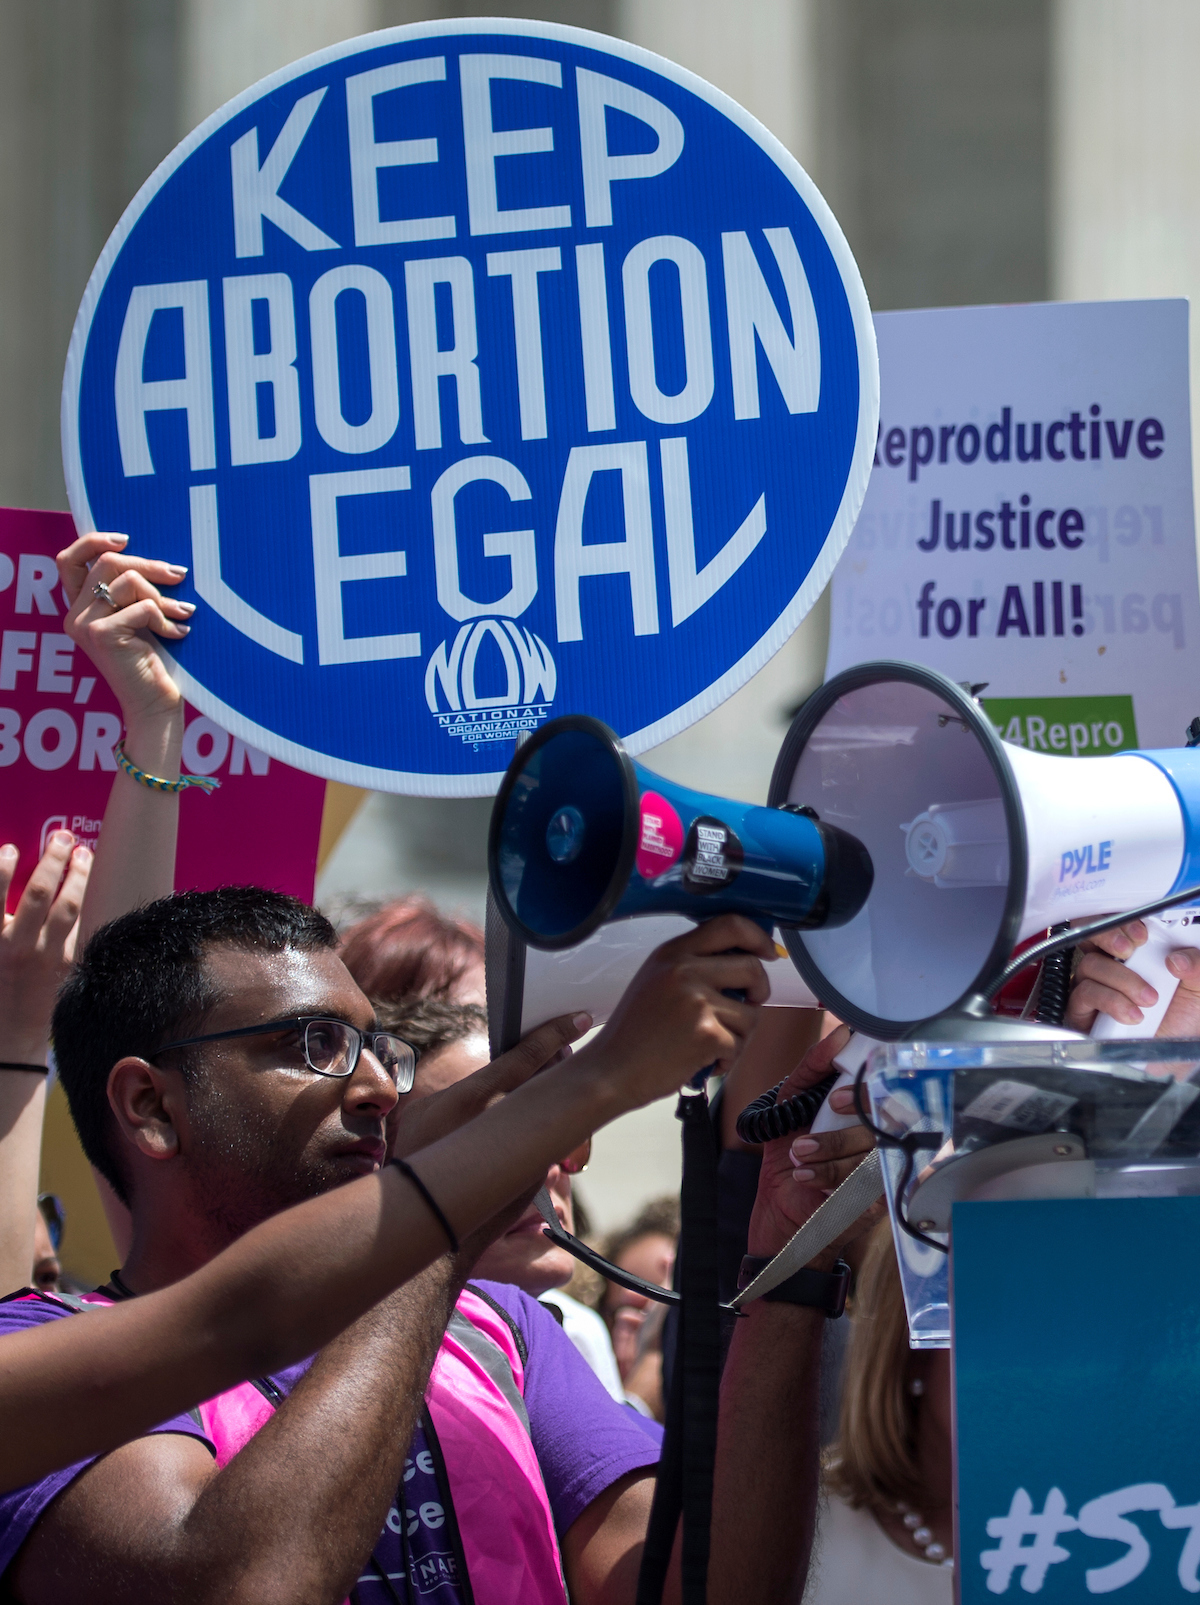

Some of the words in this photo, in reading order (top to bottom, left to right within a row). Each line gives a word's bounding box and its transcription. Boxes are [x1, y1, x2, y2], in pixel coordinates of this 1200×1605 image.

[231, 53, 685, 258] KEEP
[115, 227, 822, 478] ABORTION
[917, 494, 1085, 552] Justice
[189, 437, 767, 667] LEGAL
[916, 581, 986, 639] for
[996, 580, 1086, 639] All!
[424, 619, 557, 714] NOW
[438, 707, 547, 725] NATIONAL
[447, 719, 538, 734] ORGANIZATION
[461, 732, 482, 742] FOR
[485, 730, 521, 740] WOME
[698, 828, 725, 841] STAND
[699, 840, 719, 852] WITH
[698, 853, 723, 866] BLACK
[694, 864, 727, 878] WOMEN
